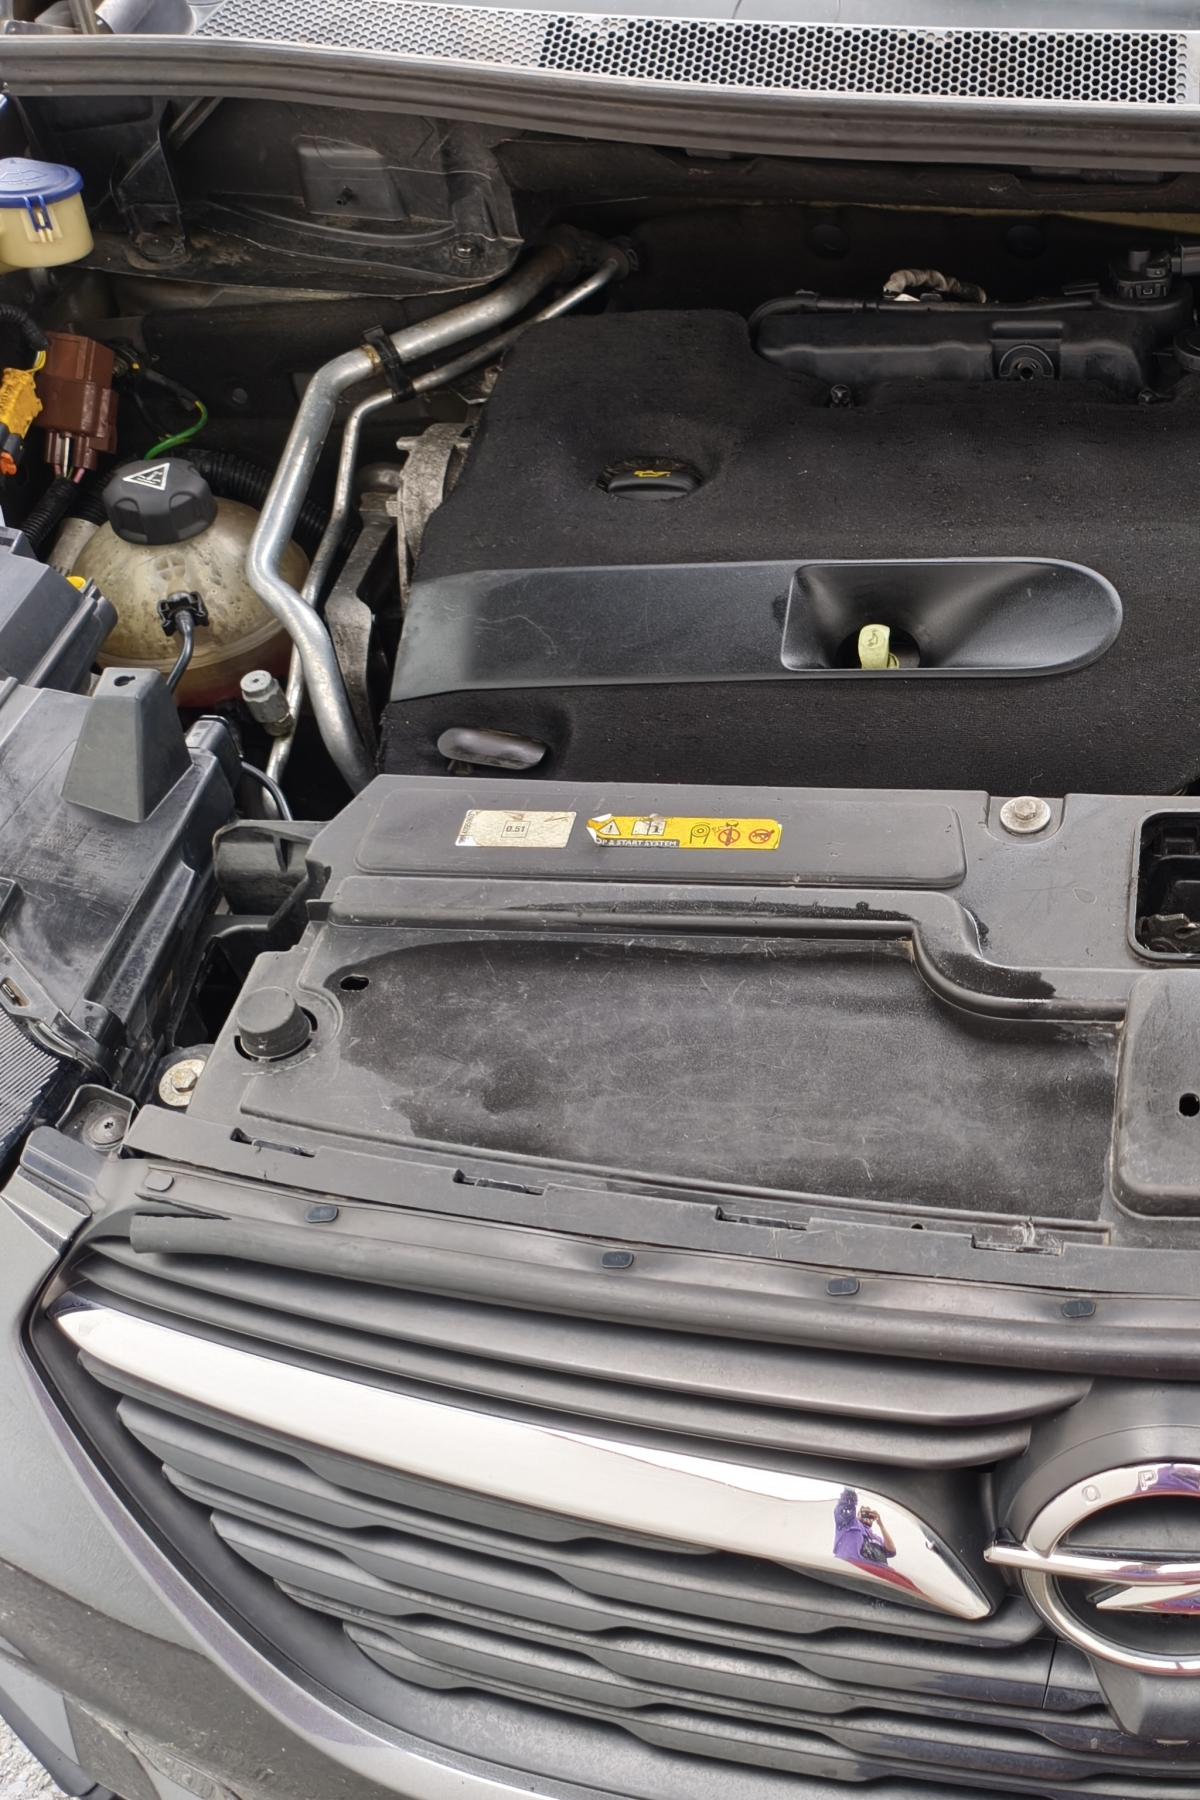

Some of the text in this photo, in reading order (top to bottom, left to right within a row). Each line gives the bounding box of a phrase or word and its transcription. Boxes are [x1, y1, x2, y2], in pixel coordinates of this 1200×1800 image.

[505, 825, 526, 833] 0.51
[616, 839, 643, 847] START
[644, 840, 678, 848] SYSTEM
